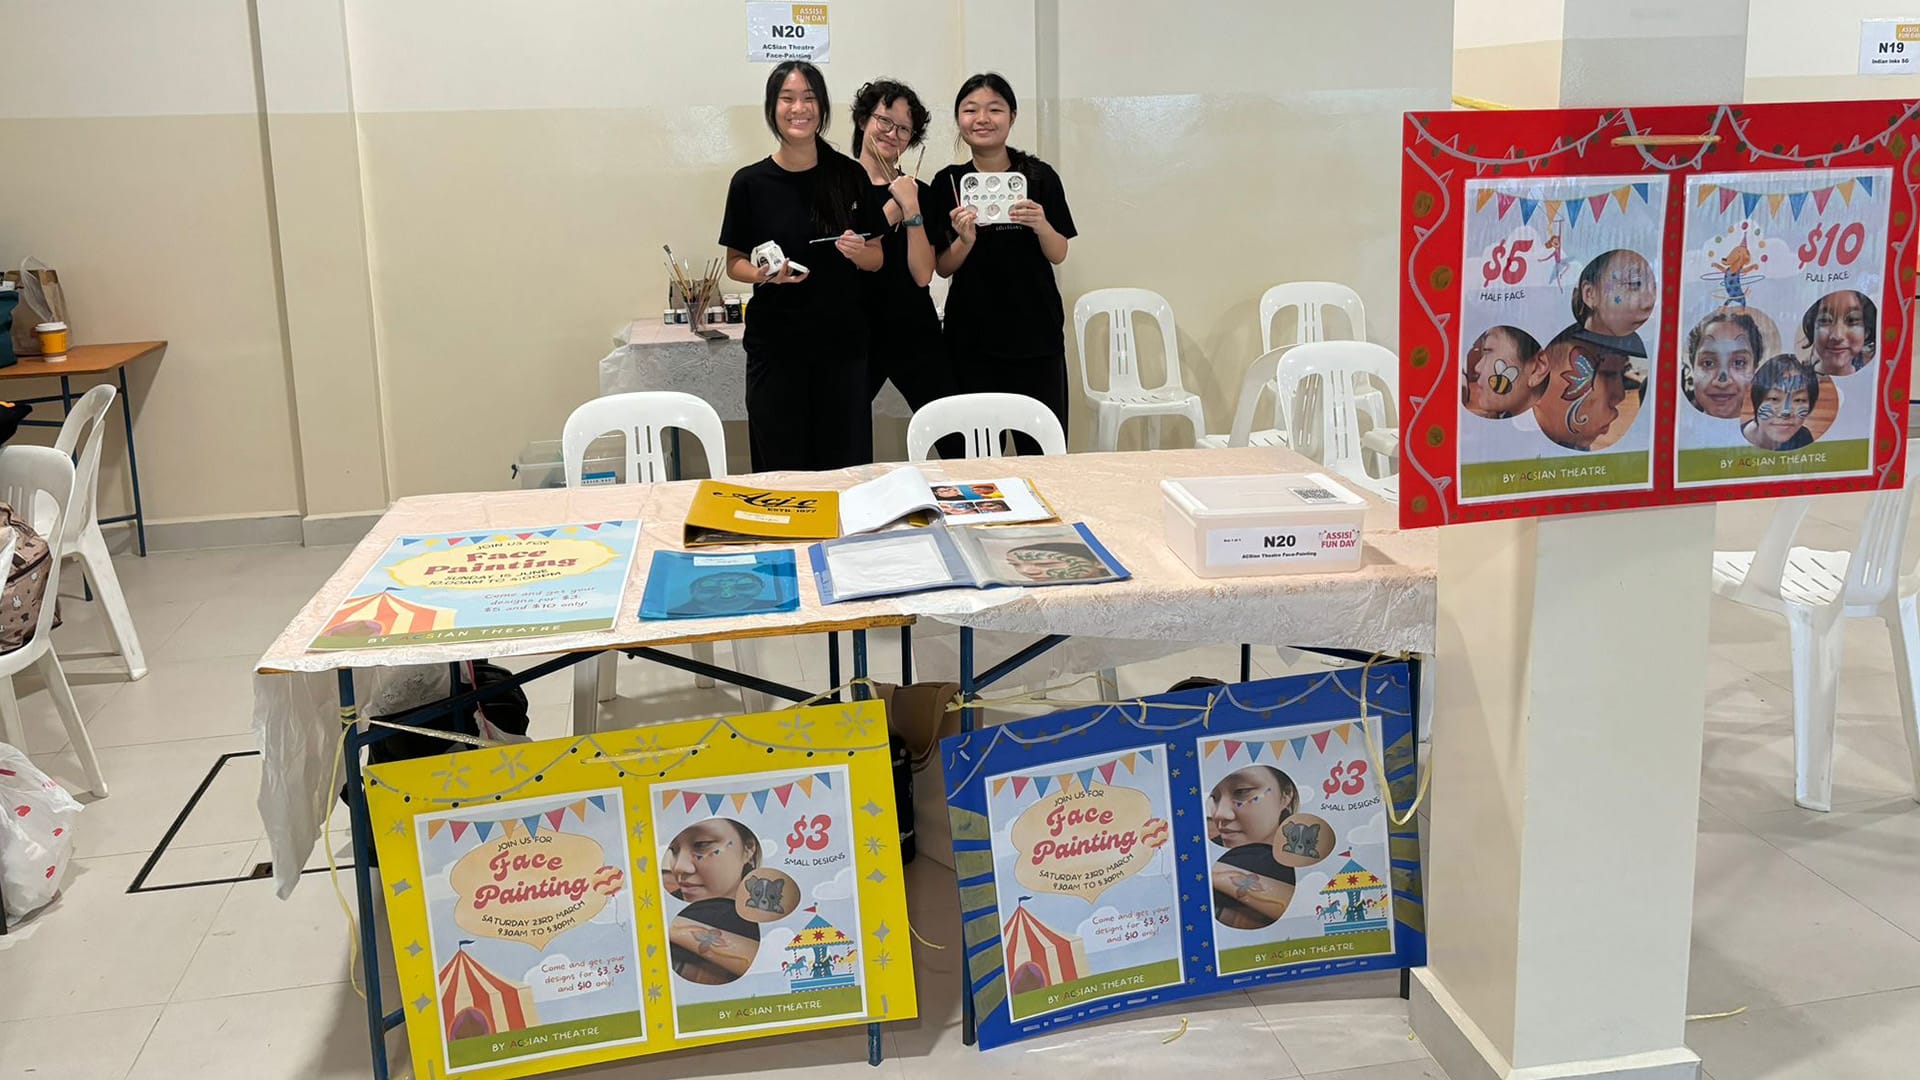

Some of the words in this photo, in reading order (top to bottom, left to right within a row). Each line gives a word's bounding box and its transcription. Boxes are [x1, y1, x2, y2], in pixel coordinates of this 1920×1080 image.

[772, 25, 805, 38] N20
[1879, 42, 1904, 53] N19
[1798, 222, 1865, 270] $10
[1483, 238, 1534, 288] $5
[1806, 273, 1824, 282] FULL
[1828, 271, 1850, 282] FACE
[1480, 292, 1502, 302] HALF
[1504, 290, 1526, 302] FACE
[1720, 459, 1733, 468] BY
[1738, 456, 1776, 468] ACSIAN
[1780, 453, 1827, 465] THEATRE
[1503, 473, 1516, 484] BY
[1520, 470, 1556, 480] ACSIAN
[1561, 466, 1607, 478] THEATRE
[1264, 535, 1297, 548] N20
[1321, 540, 1338, 548] FUN
[1340, 540, 1357, 548] DAY
[1326, 531, 1352, 540] ASSISI
[476, 542, 503, 551] JOIN
[466, 550, 547, 562] Face
[424, 558, 579, 575] Painting
[506, 604, 529, 612] and
[533, 602, 556, 610] $10
[560, 600, 588, 608] only!
[368, 636, 390, 645] BY
[398, 630, 469, 642] ACSIAN
[480, 624, 562, 636] THEATRE
[1323, 759, 1368, 800] $3
[1054, 794, 1073, 806] JOIN
[1074, 792, 1086, 800] US
[1087, 790, 1104, 798] FOR
[1320, 802, 1345, 812] SMALL
[1348, 796, 1380, 811] DESIGNS
[1046, 806, 1114, 836] Face
[786, 814, 832, 854] $3
[498, 839, 518, 852] JOIN
[520, 836, 532, 845] US
[534, 836, 553, 844] FOR
[1031, 830, 1138, 866] Painting
[489, 850, 563, 882] Face
[784, 857, 810, 866] SMALL
[812, 852, 846, 866] DESIGNS
[1040, 870, 1083, 882] SATURDAY
[1084, 869, 1105, 880] 23RD
[1106, 854, 1134, 872] MARCH
[473, 876, 590, 910] Painting
[1084, 881, 1096, 890] TO
[482, 914, 530, 928] SATURDAY
[532, 915, 554, 926] 23RD
[556, 901, 586, 919] MARCH
[1092, 916, 1114, 925] Come
[1118, 912, 1133, 920] and
[1135, 910, 1148, 920] get
[1152, 906, 1170, 916] your
[531, 928, 544, 936] TO
[1095, 926, 1124, 936] designs
[1127, 922, 1140, 930] for
[1159, 914, 1170, 924] $5
[1106, 935, 1122, 944] and
[1124, 930, 1139, 941] $10
[1142, 927, 1160, 938] only!
[1255, 953, 1267, 964] BY
[1270, 947, 1306, 960] ACSIAN
[1310, 942, 1355, 954] THEATRE
[541, 964, 566, 974] Come
[569, 960, 586, 968] and
[588, 958, 602, 968] get
[606, 954, 626, 965] your
[545, 974, 576, 985] designs
[614, 964, 626, 974] $5
[558, 984, 574, 993] and
[577, 980, 592, 991] $10
[596, 977, 615, 988] only!
[1048, 995, 1060, 1004] BY
[1064, 985, 1098, 1001] ACSIAN
[1102, 974, 1146, 991] THEATRE
[719, 1009, 732, 1019] BY
[736, 1004, 772, 1017] ACSIAN
[776, 999, 823, 1012] THEATRE
[492, 1042, 505, 1052] BY
[510, 1035, 549, 1049] ACSIAN
[552, 1026, 600, 1041] THEATRE
